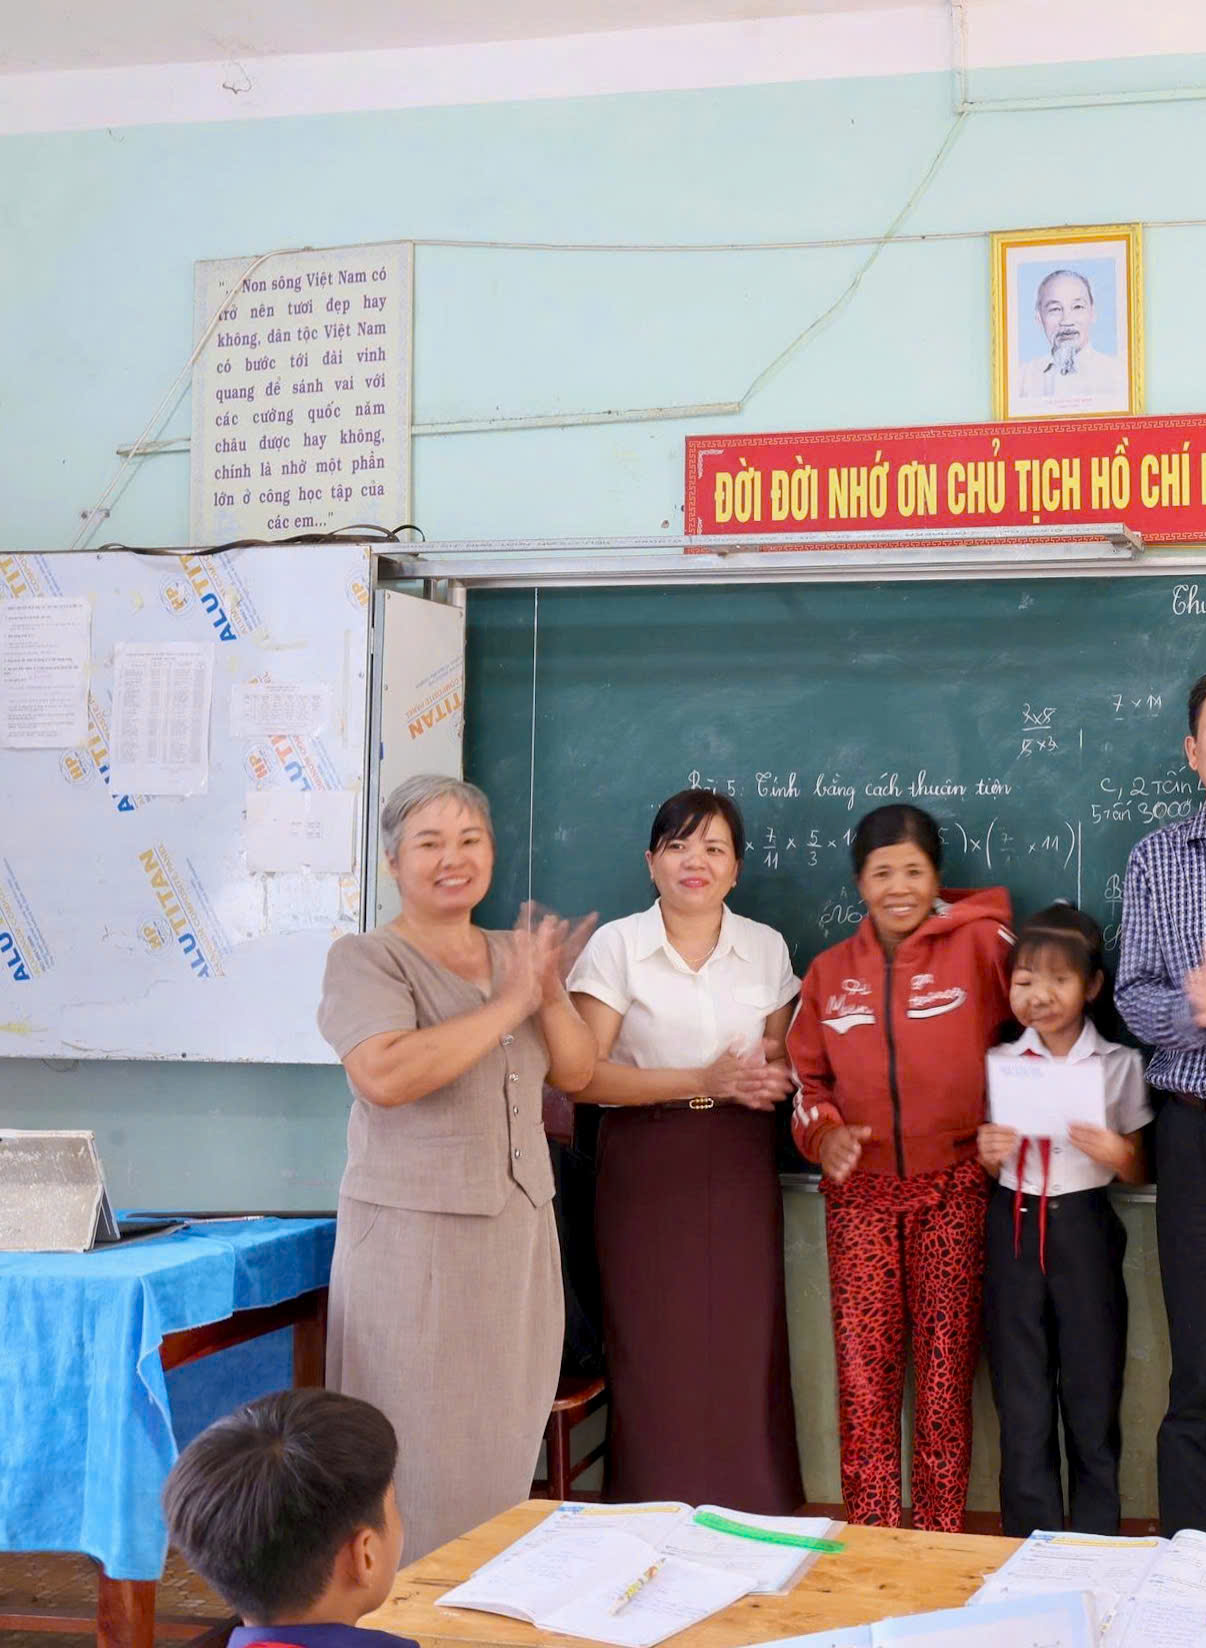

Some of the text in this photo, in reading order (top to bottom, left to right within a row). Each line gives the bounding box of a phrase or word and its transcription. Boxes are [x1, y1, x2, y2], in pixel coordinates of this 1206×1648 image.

[242, 266, 387, 293] Non sông Việt Nam có
[250, 303, 274, 319] nên
[288, 299, 313, 316] tươi
[326, 297, 350, 314] đẹp
[363, 294, 387, 311] hay
[217, 321, 386, 349] không, dân tộc Việt Nam
[216, 347, 386, 374] có bước tới đài vinh
[216, 373, 385, 403] quang để sánh vai với
[215, 400, 385, 426] các cường quốc năm
[215, 428, 385, 453] châu được hay không,
[214, 450, 385, 480] chính là nhờ một phần
[214, 480, 384, 506] lớn ở công học tập của
[714, 455, 761, 523] ĐỜI
[770, 454, 818, 522] ĐỜI
[828, 448, 888, 519] NHỚ
[897, 458, 939, 517] ƠN
[947, 437, 1006, 514] CHỦ
[1015, 455, 1080, 525] TỊCH
[1090, 439, 1130, 508] HỒ
[1140, 441, 1191, 508] CHÍ
[267, 514, 289, 529] các
[755, 771, 800, 798] Tính
[813, 773, 856, 811] bằng
[865, 772, 903, 797] cách
[975, 777, 1012, 800] tiện
[808, 851, 818, 866] 3
